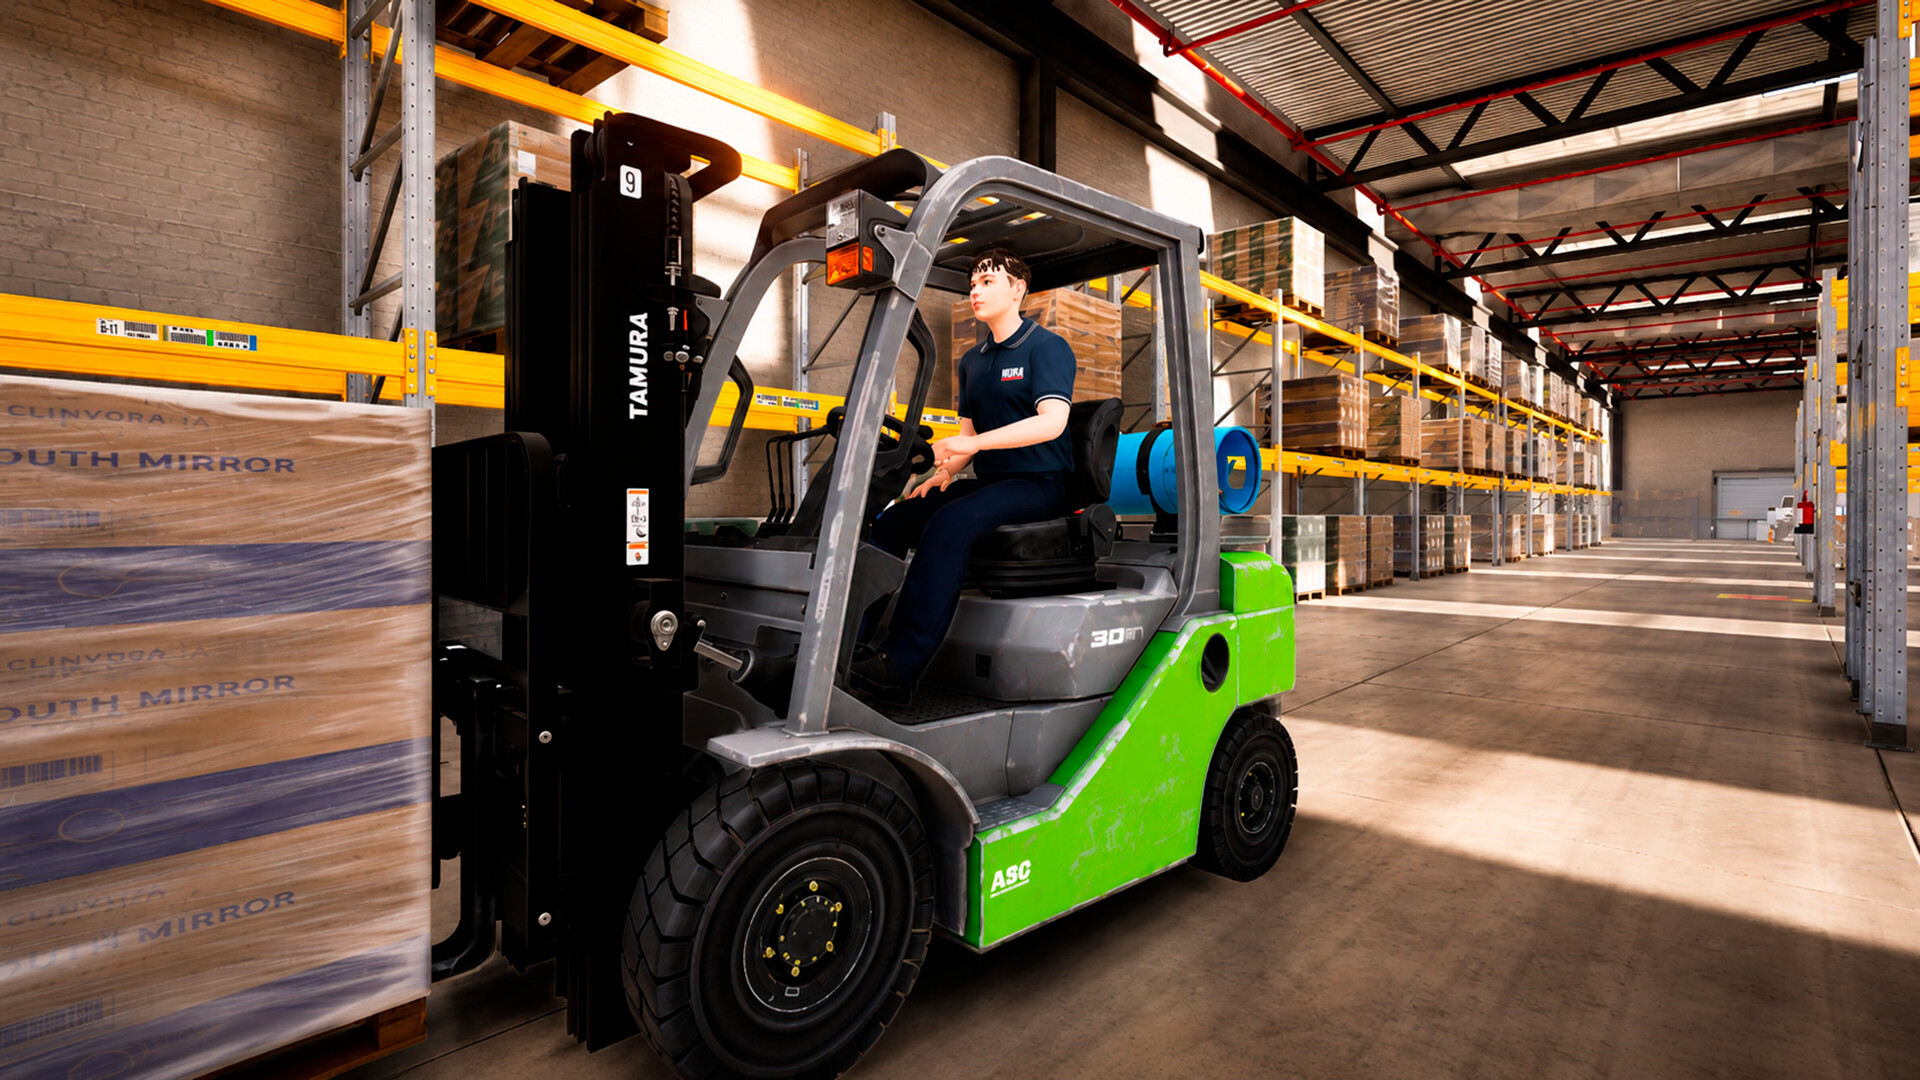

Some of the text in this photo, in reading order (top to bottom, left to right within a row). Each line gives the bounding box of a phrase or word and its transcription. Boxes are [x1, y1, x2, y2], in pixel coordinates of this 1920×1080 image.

[625, 171, 635, 193] 9
[629, 312, 648, 419] TAMURA
[7, 404, 165, 425] CLINVORA
[139, 452, 295, 474] MIRROR
[139, 675, 296, 708] MIRROR
[990, 860, 1031, 892] ASC
[138, 891, 295, 943] MIRROR
